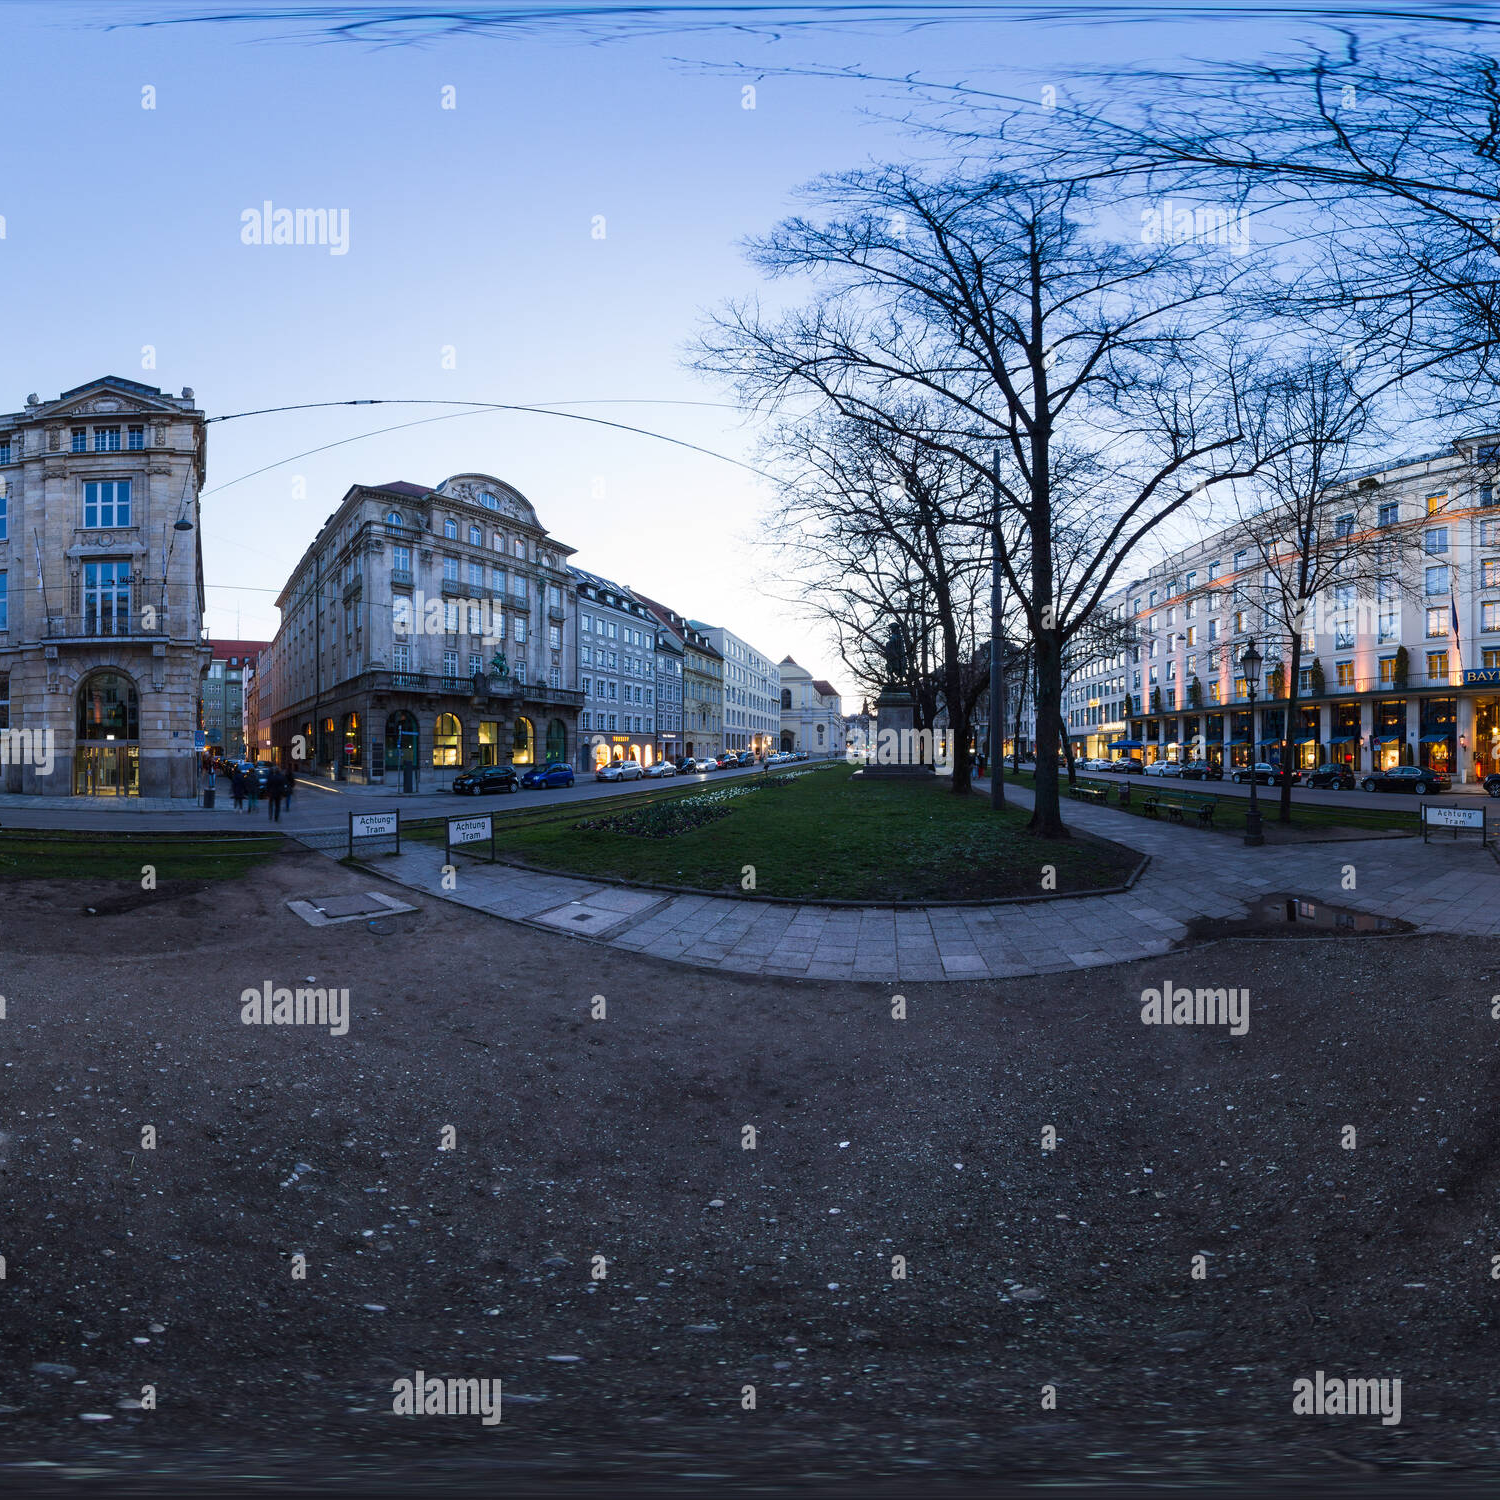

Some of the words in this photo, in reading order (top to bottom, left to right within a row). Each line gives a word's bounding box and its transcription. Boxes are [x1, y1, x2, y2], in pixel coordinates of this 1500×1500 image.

[1437, 809, 1472, 819] Achtung
[360, 816, 391, 825] Achtung
[1444, 817, 1466, 825] Tram
[365, 825, 385, 834] Tram
[455, 820, 486, 831] Achtung
[461, 832, 481, 840] Tram
